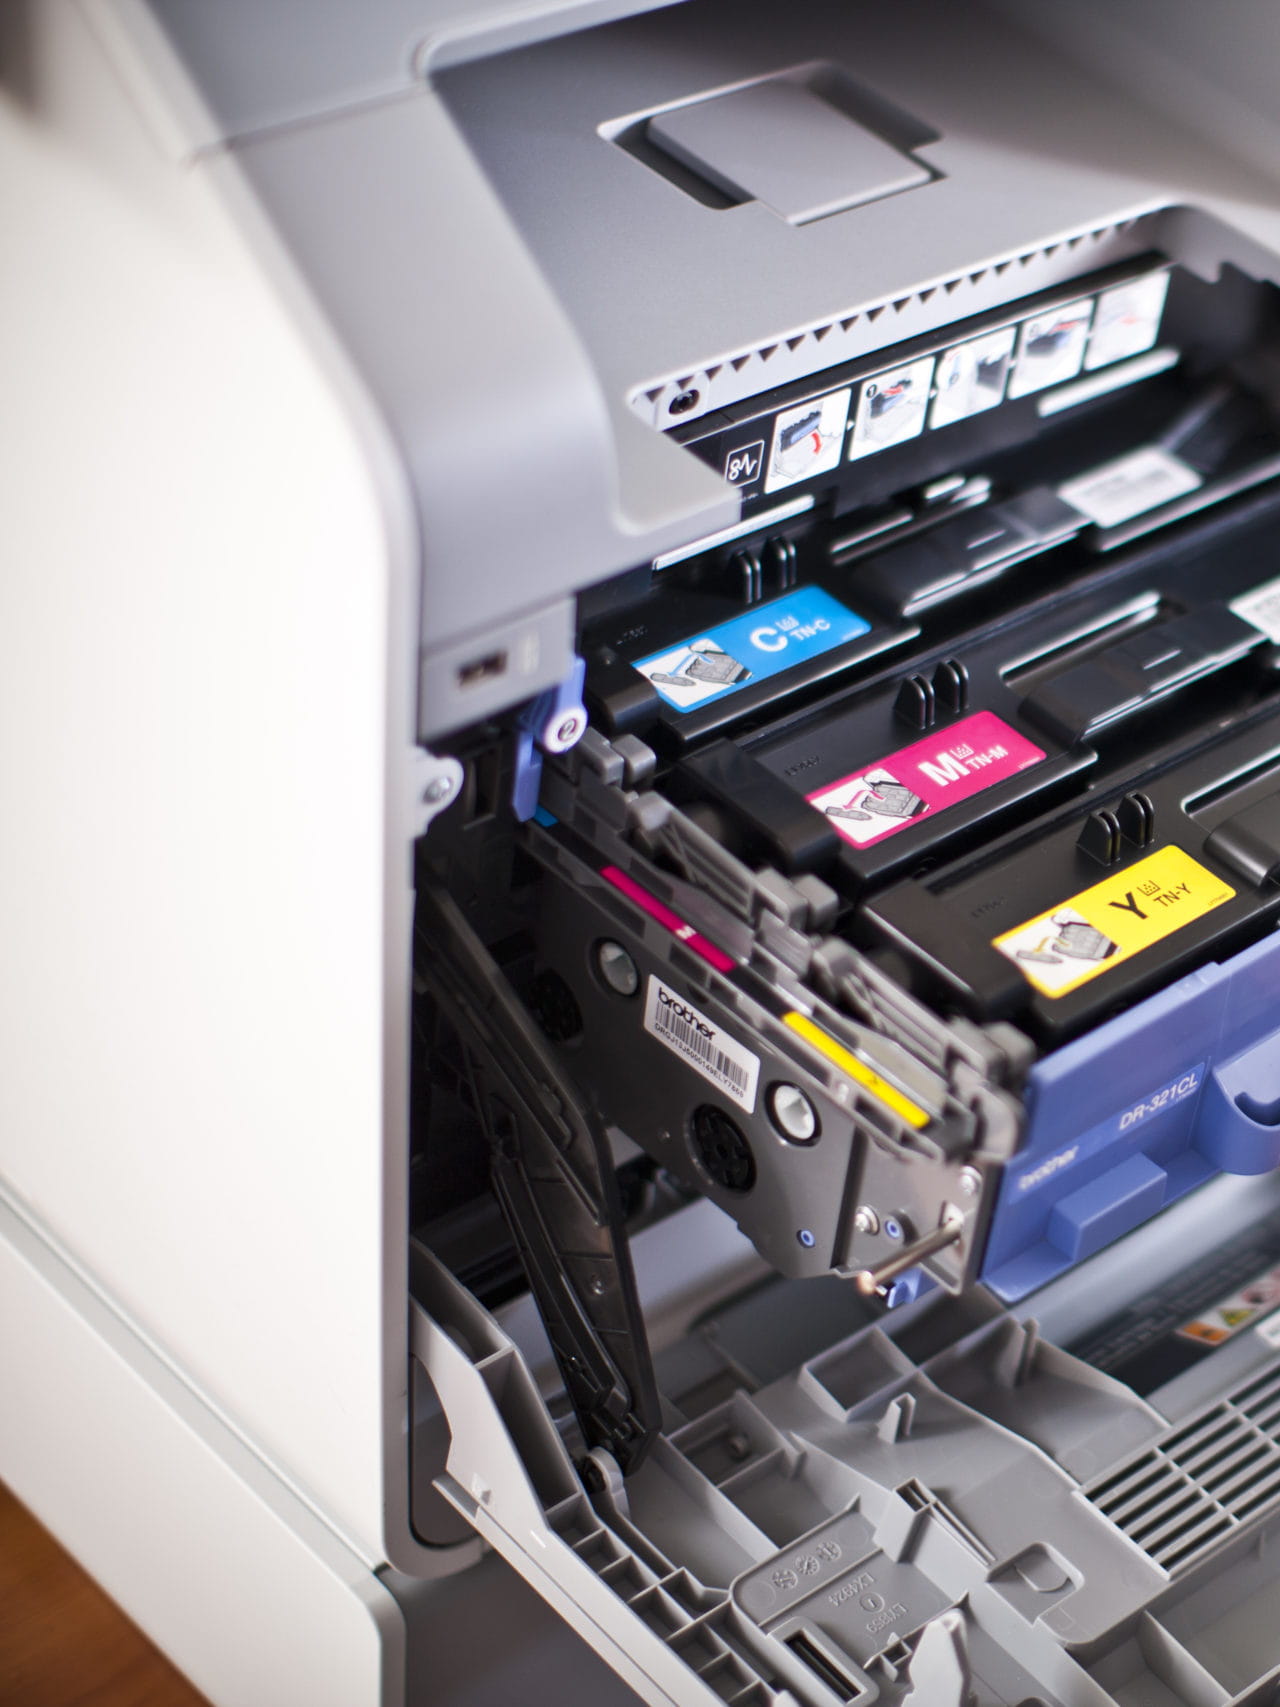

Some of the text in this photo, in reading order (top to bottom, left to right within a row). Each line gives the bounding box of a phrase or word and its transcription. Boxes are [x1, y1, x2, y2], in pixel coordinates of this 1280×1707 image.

[749, 627, 788, 652] C
[790, 618, 832, 642] TN-C
[918, 752, 971, 787] M
[965, 744, 1009, 769] TN-M
[1109, 892, 1148, 920] Y
[1153, 882, 1191, 907] TN-Y
[658, 987, 717, 1041] brother
[1119, 1073, 1199, 1132] DR-321CL
